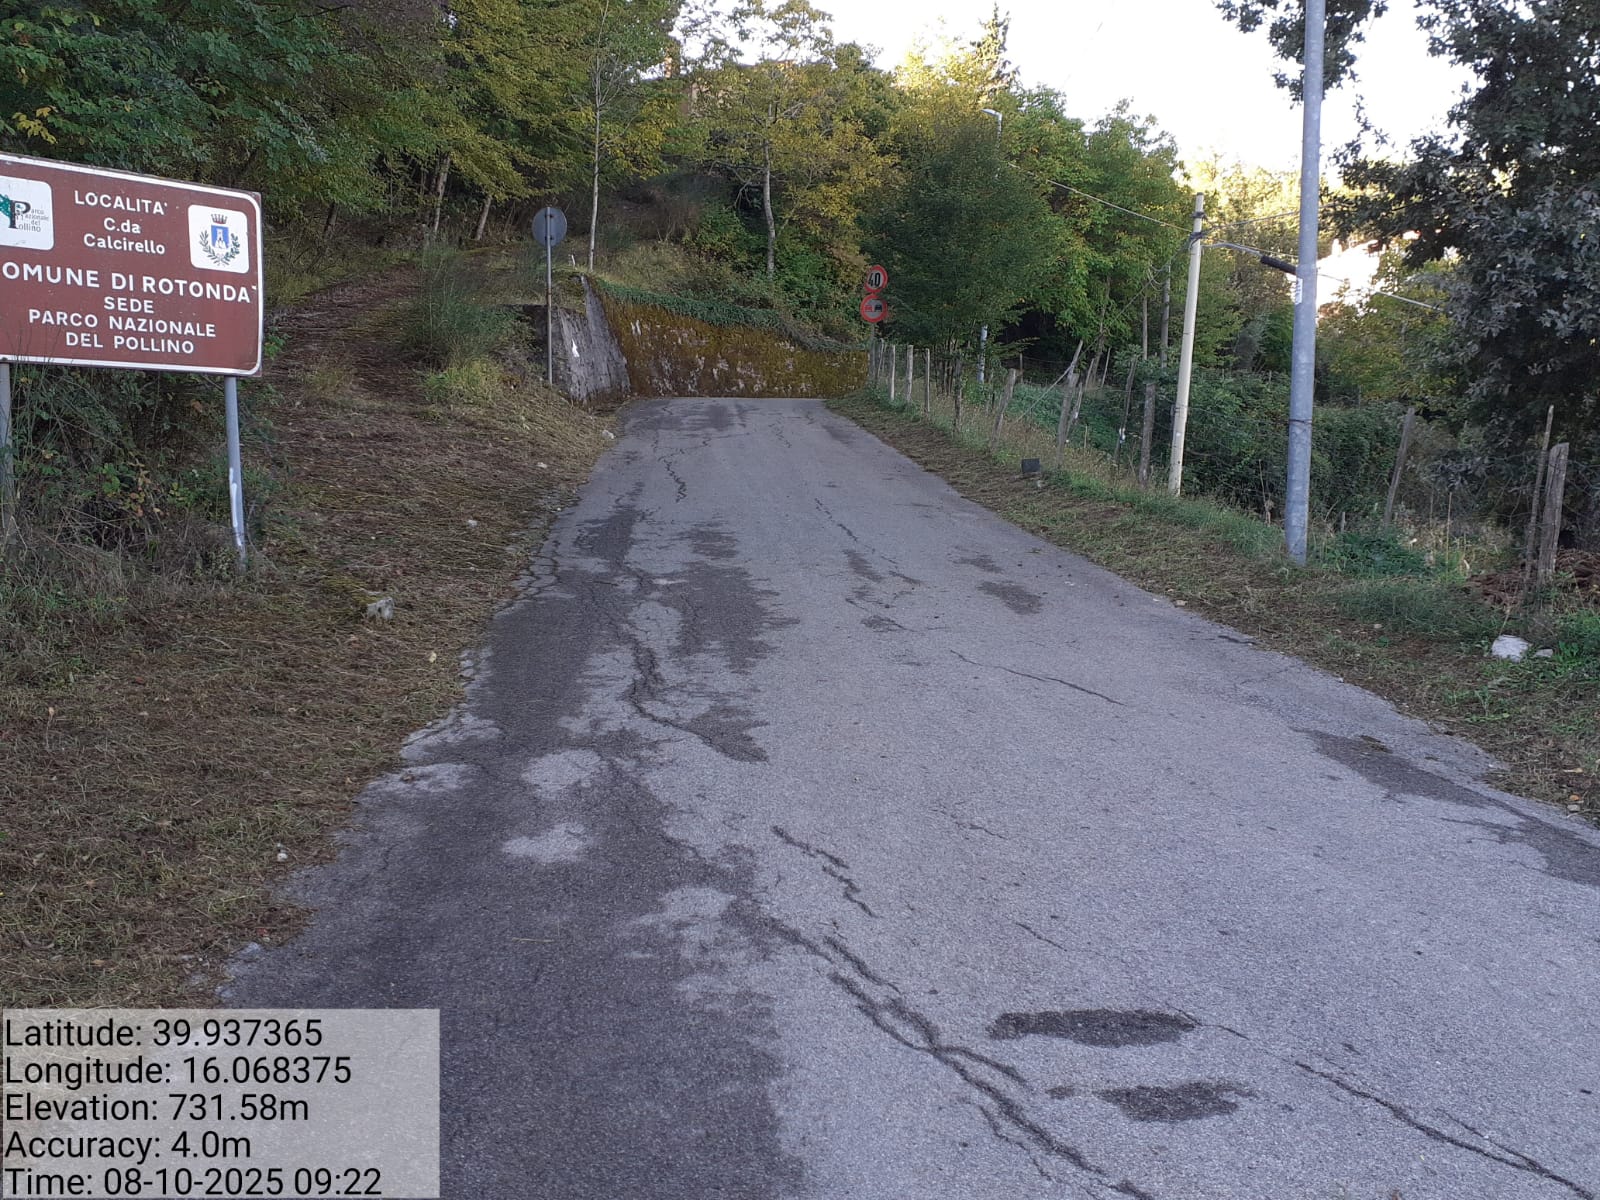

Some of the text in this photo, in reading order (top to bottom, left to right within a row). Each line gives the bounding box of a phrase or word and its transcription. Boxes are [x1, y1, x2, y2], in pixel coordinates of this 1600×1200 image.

[103, 217, 142, 234] C.da
[83, 233, 166, 255] Calcirello
[2, 261, 100, 288] OMUNE
[111, 272, 135, 292] DI
[868, 272, 881, 287] 40
[103, 296, 155, 314] SEDE
[28, 308, 217, 338] PARCO NAZIONALE
[65, 331, 195, 354] DEL POLLINO
